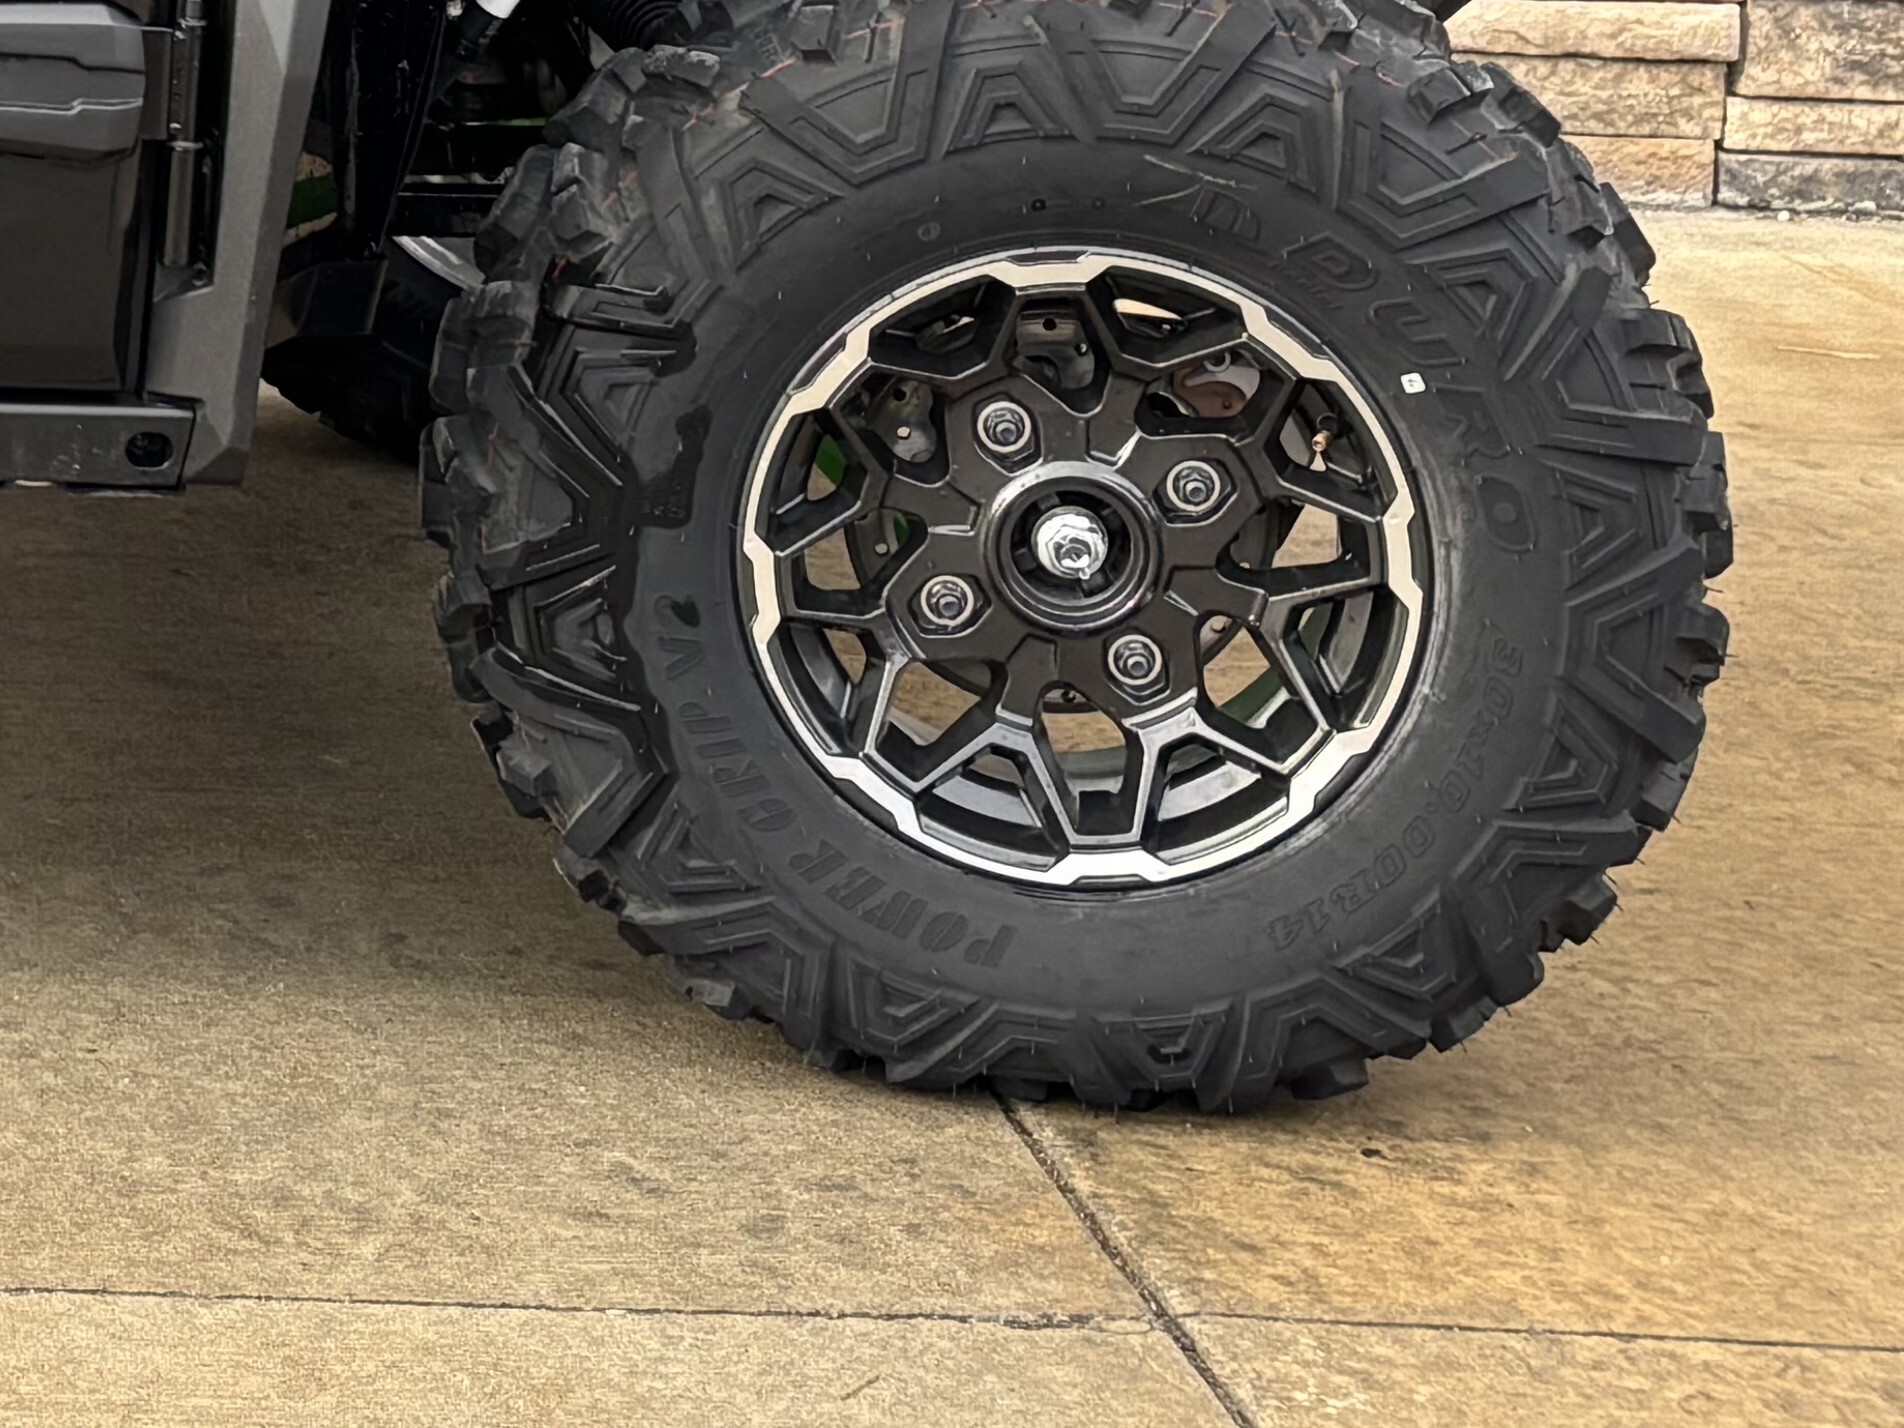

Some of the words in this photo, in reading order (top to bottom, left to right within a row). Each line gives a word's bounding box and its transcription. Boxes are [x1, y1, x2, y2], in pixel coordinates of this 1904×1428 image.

[1284, 231, 1534, 553] DURO
[679, 702, 792, 832] GRIP
[1266, 638, 1523, 947] 30x10.00R14
[790, 839, 1018, 968] POWER
